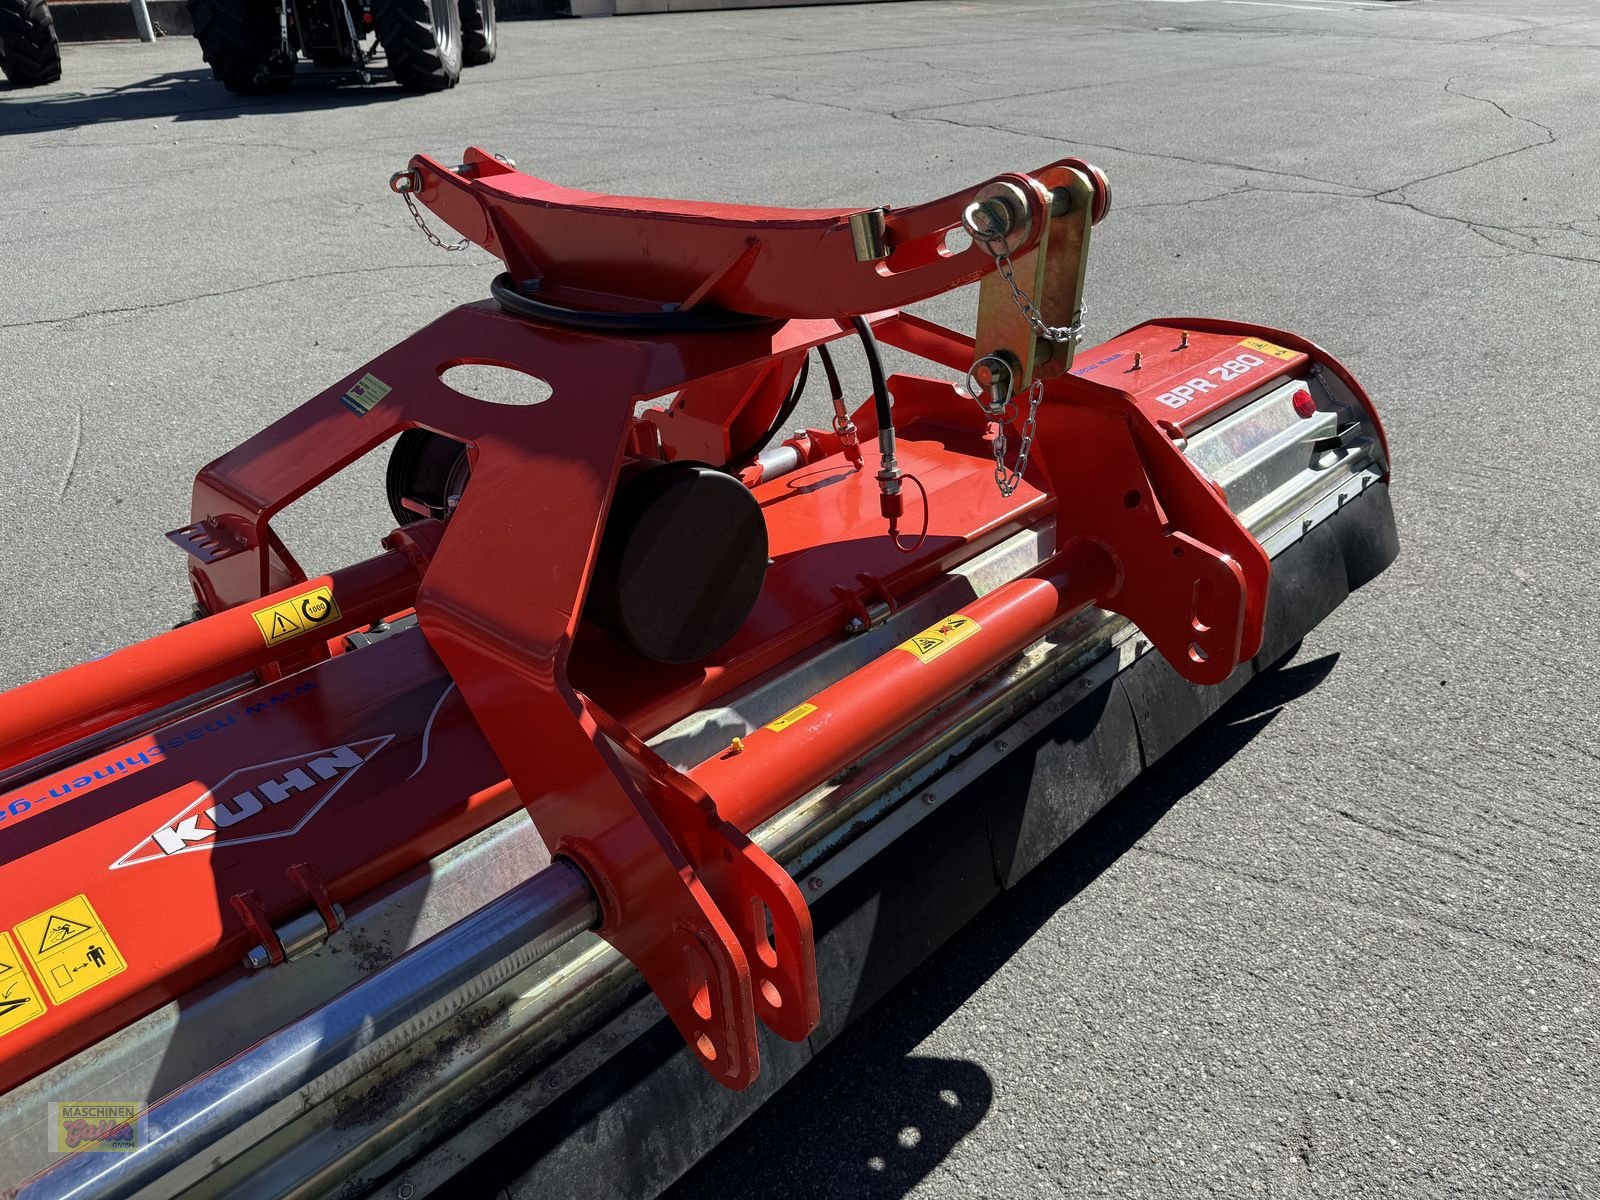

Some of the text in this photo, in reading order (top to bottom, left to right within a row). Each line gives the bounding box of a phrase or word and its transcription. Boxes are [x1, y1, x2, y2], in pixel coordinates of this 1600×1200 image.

[1155, 353, 1265, 409] BPR 280
[309, 603, 326, 614] 1000
[151, 745, 365, 855] KUHN
